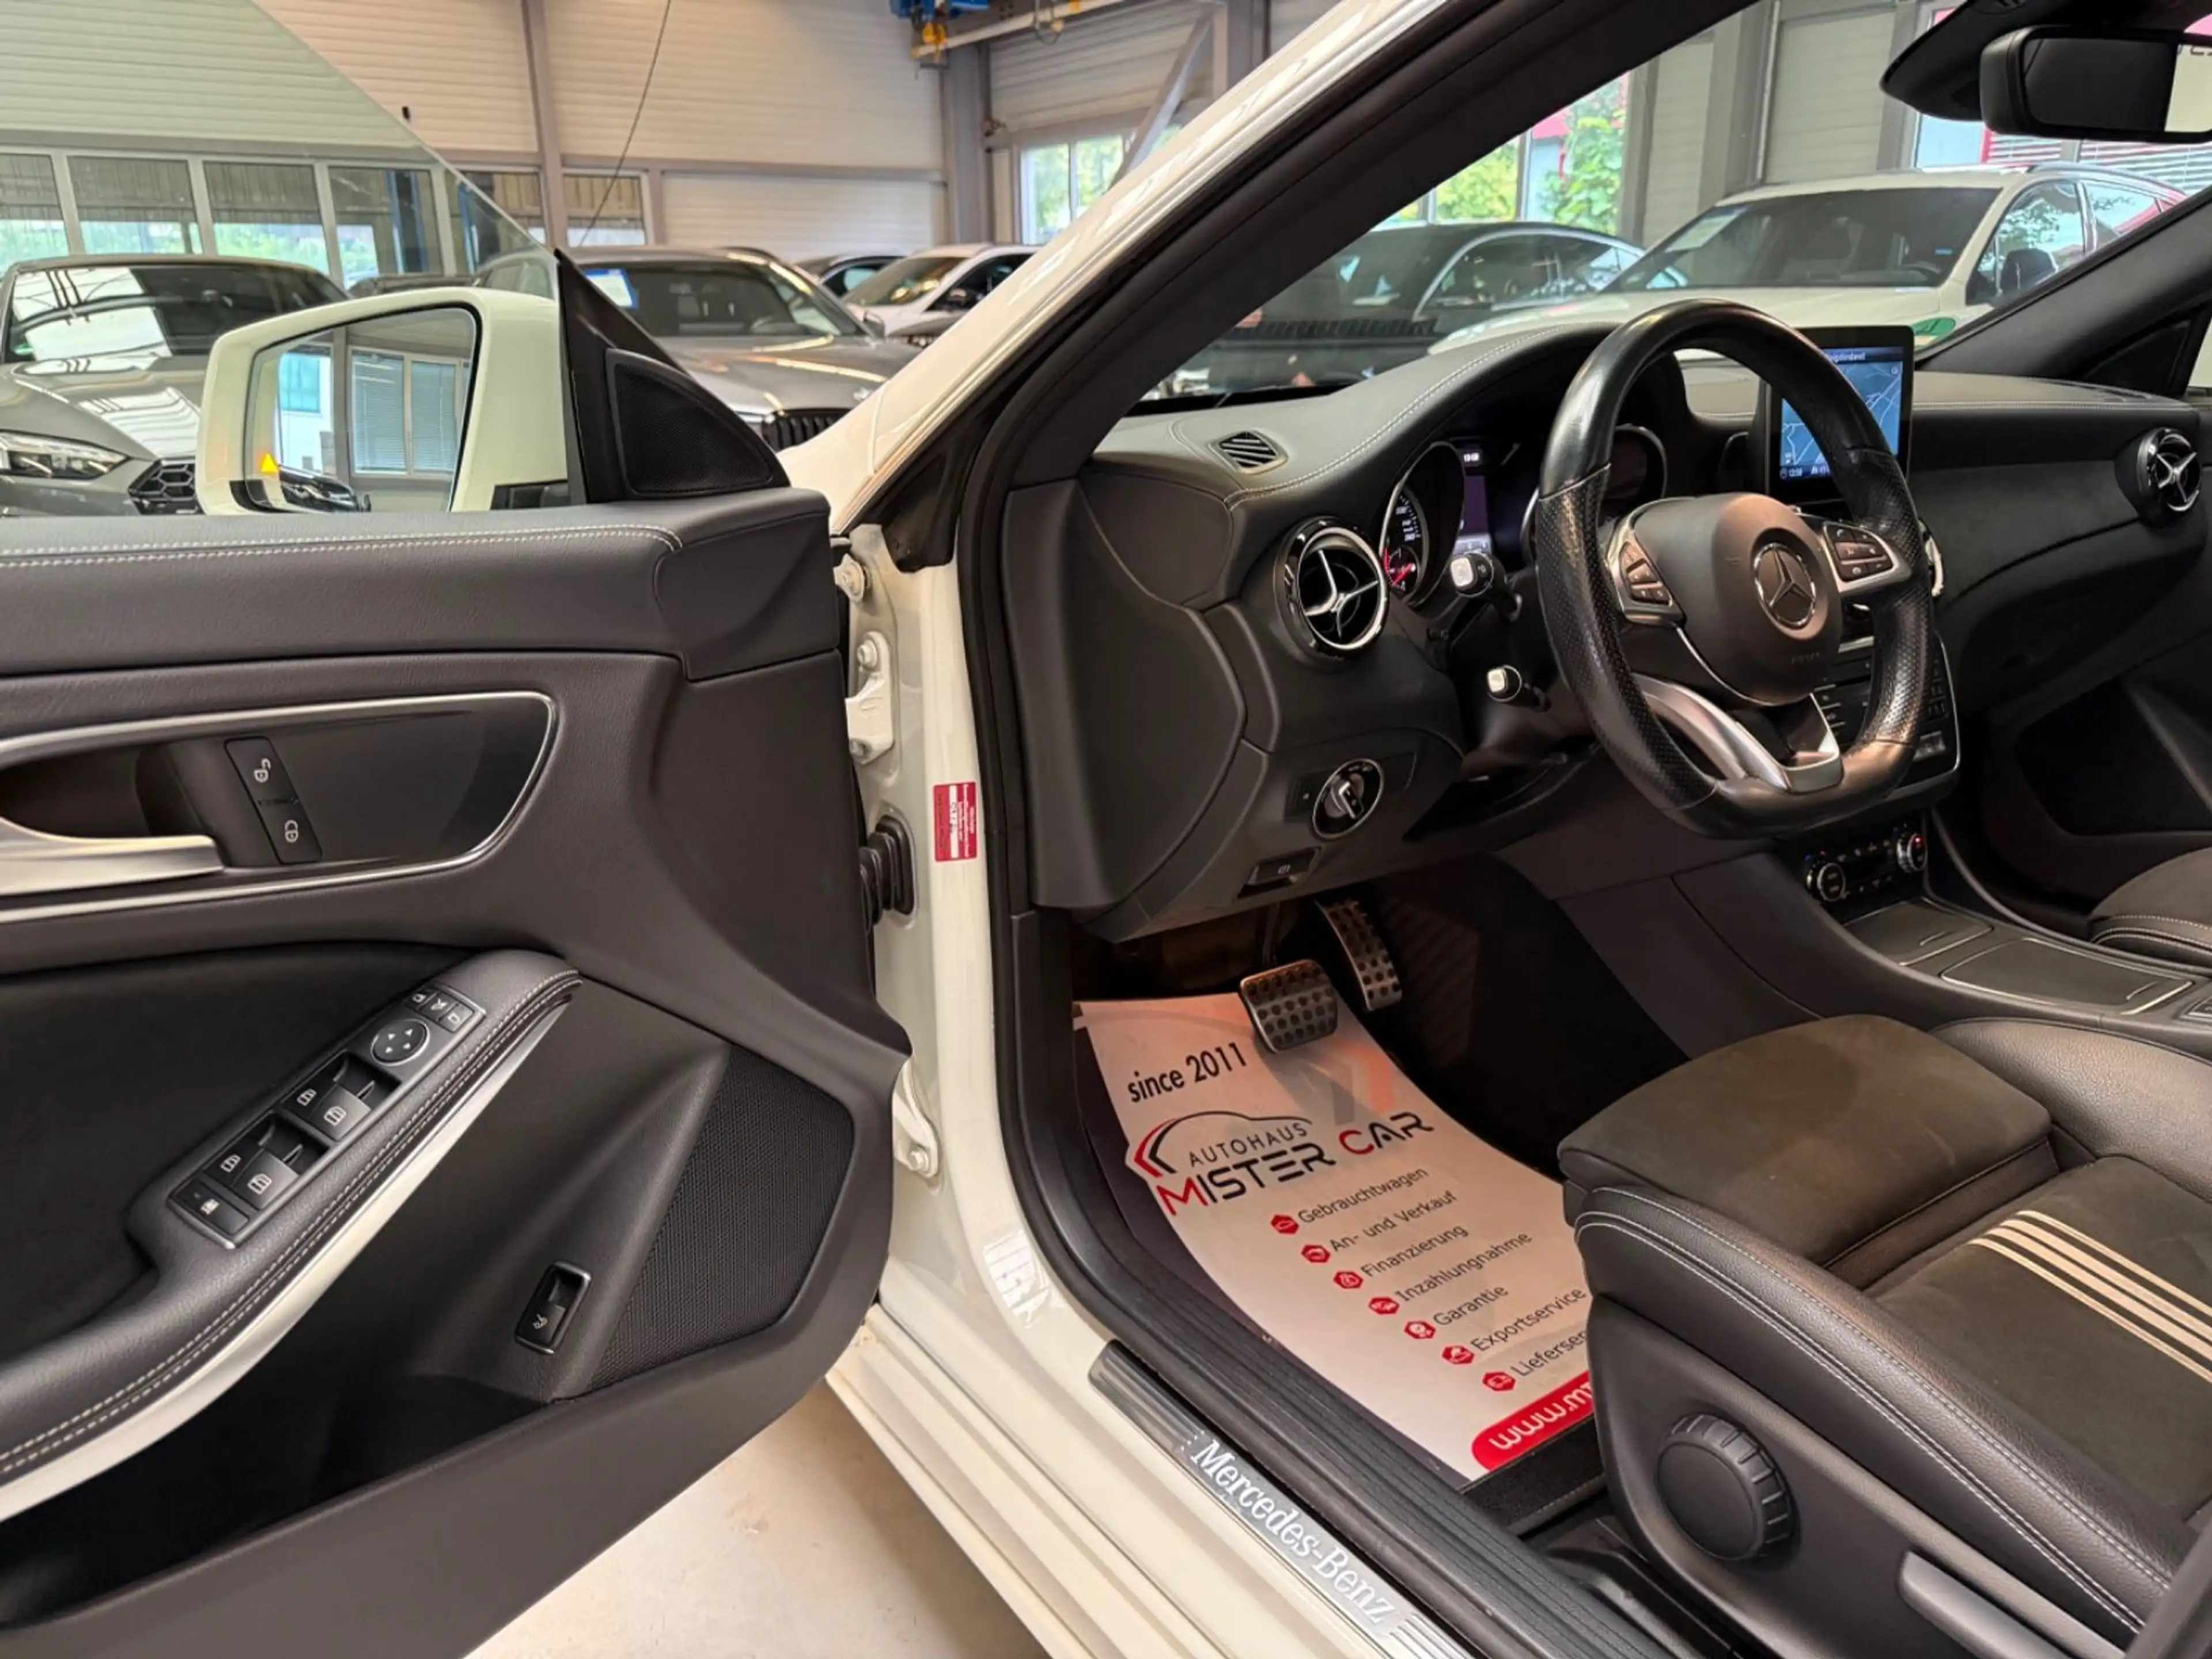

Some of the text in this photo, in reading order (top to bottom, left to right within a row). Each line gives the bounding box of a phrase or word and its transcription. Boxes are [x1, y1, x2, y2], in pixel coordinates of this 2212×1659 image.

[1127, 1042, 1248, 1103] since 2011
[1156, 1111, 1434, 1217] MISTER CAR
[1188, 1121, 1308, 1168] AUTOHAUS
[1297, 1168, 1429, 1224] Gebrauchtwagen
[1330, 1190, 1458, 1252] An- und Verkauf
[1360, 1225, 1469, 1277] Finanzierung
[1396, 1232, 1533, 1302] Inzahlungnahme
[1433, 1286, 1509, 1325] Garantie
[1470, 1289, 1586, 1351] Exportservice
[1191, 1438, 1396, 1626] Mercedes-Benz
